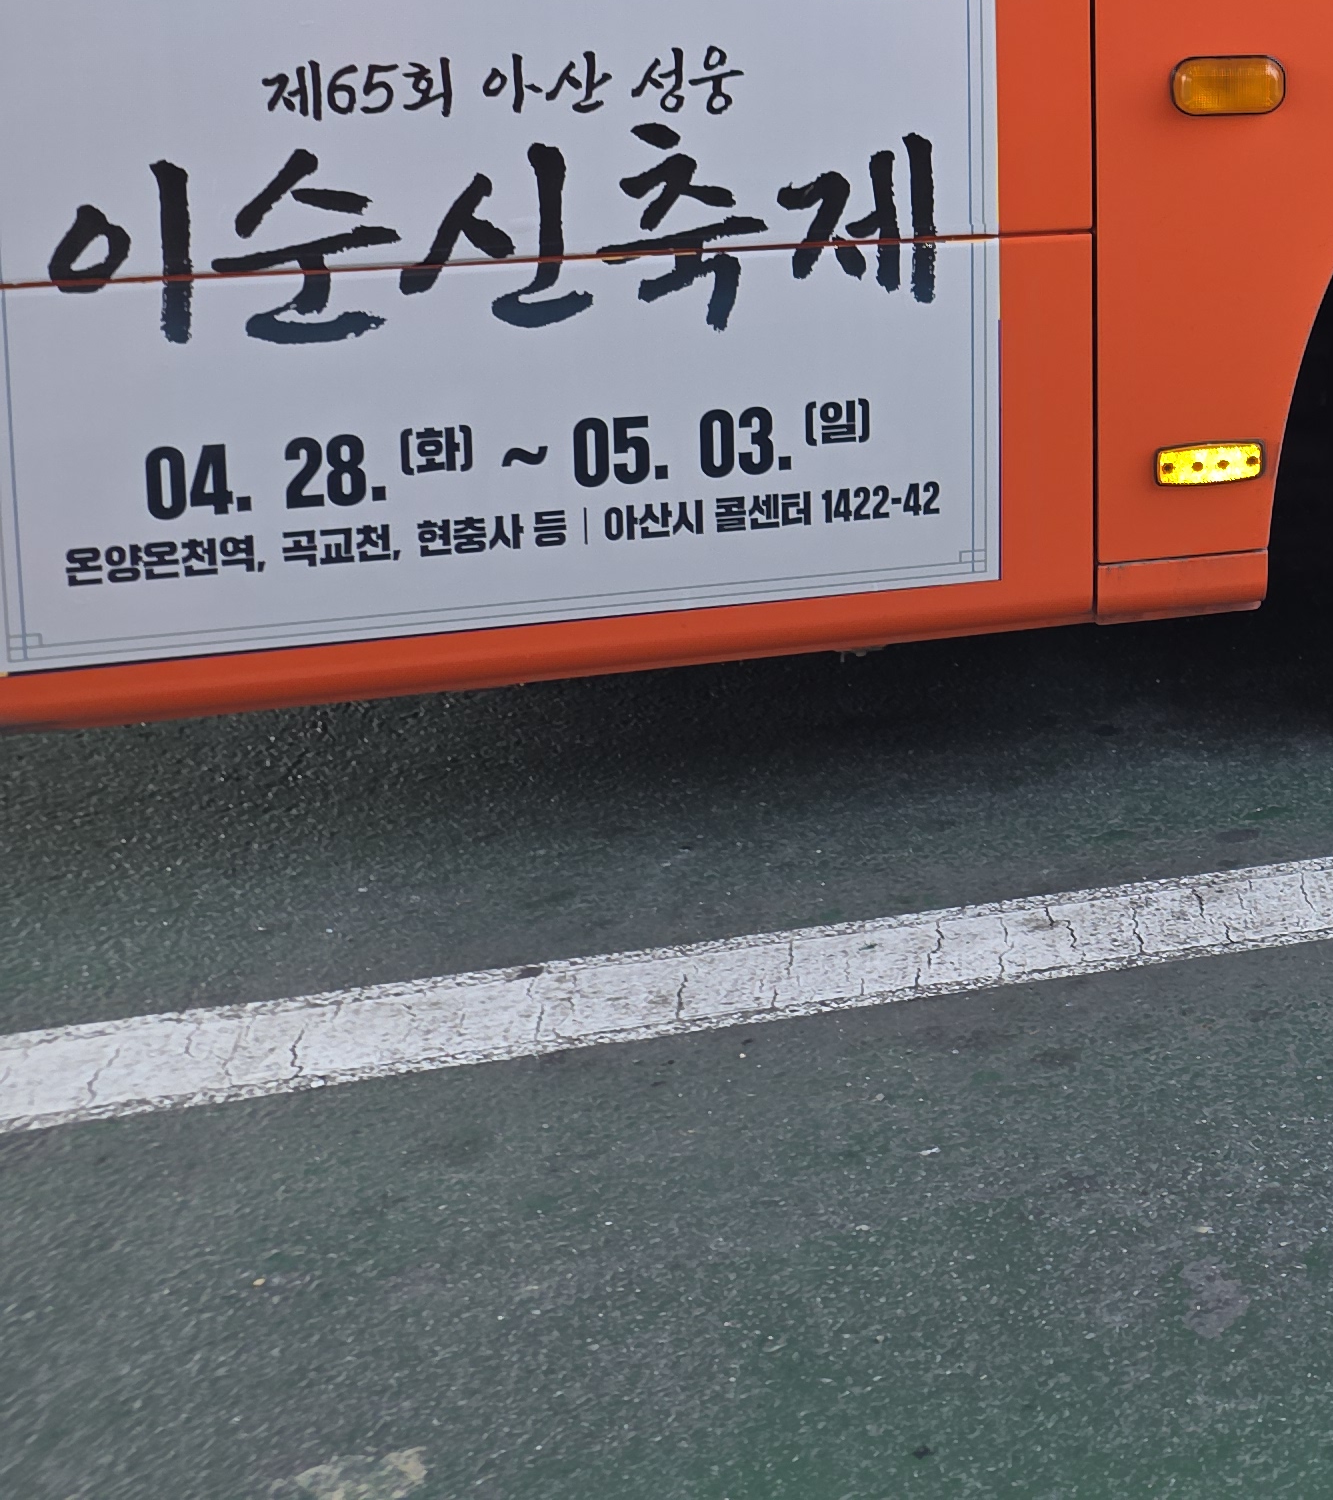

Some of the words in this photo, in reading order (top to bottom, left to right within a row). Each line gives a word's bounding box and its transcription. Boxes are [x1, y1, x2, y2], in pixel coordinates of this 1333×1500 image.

[261, 57, 453, 122] 제65회
[481, 50, 613, 115] 아산
[631, 45, 745, 116] 성웅
[46, 122, 937, 344] 이순신축제
[144, 443, 253, 521] 04.
[500, 445, 549, 468] ~
[572, 415, 669, 488] 05.
[65, 534, 267, 588] 온양온천역,
[281, 523, 402, 568] 곡교천,
[416, 512, 525, 559] 현충사
[532, 509, 568, 548] 등
[603, 498, 705, 543] 아산시
[714, 490, 812, 534] 콜센터
[821, 480, 941, 524] 1422-42
